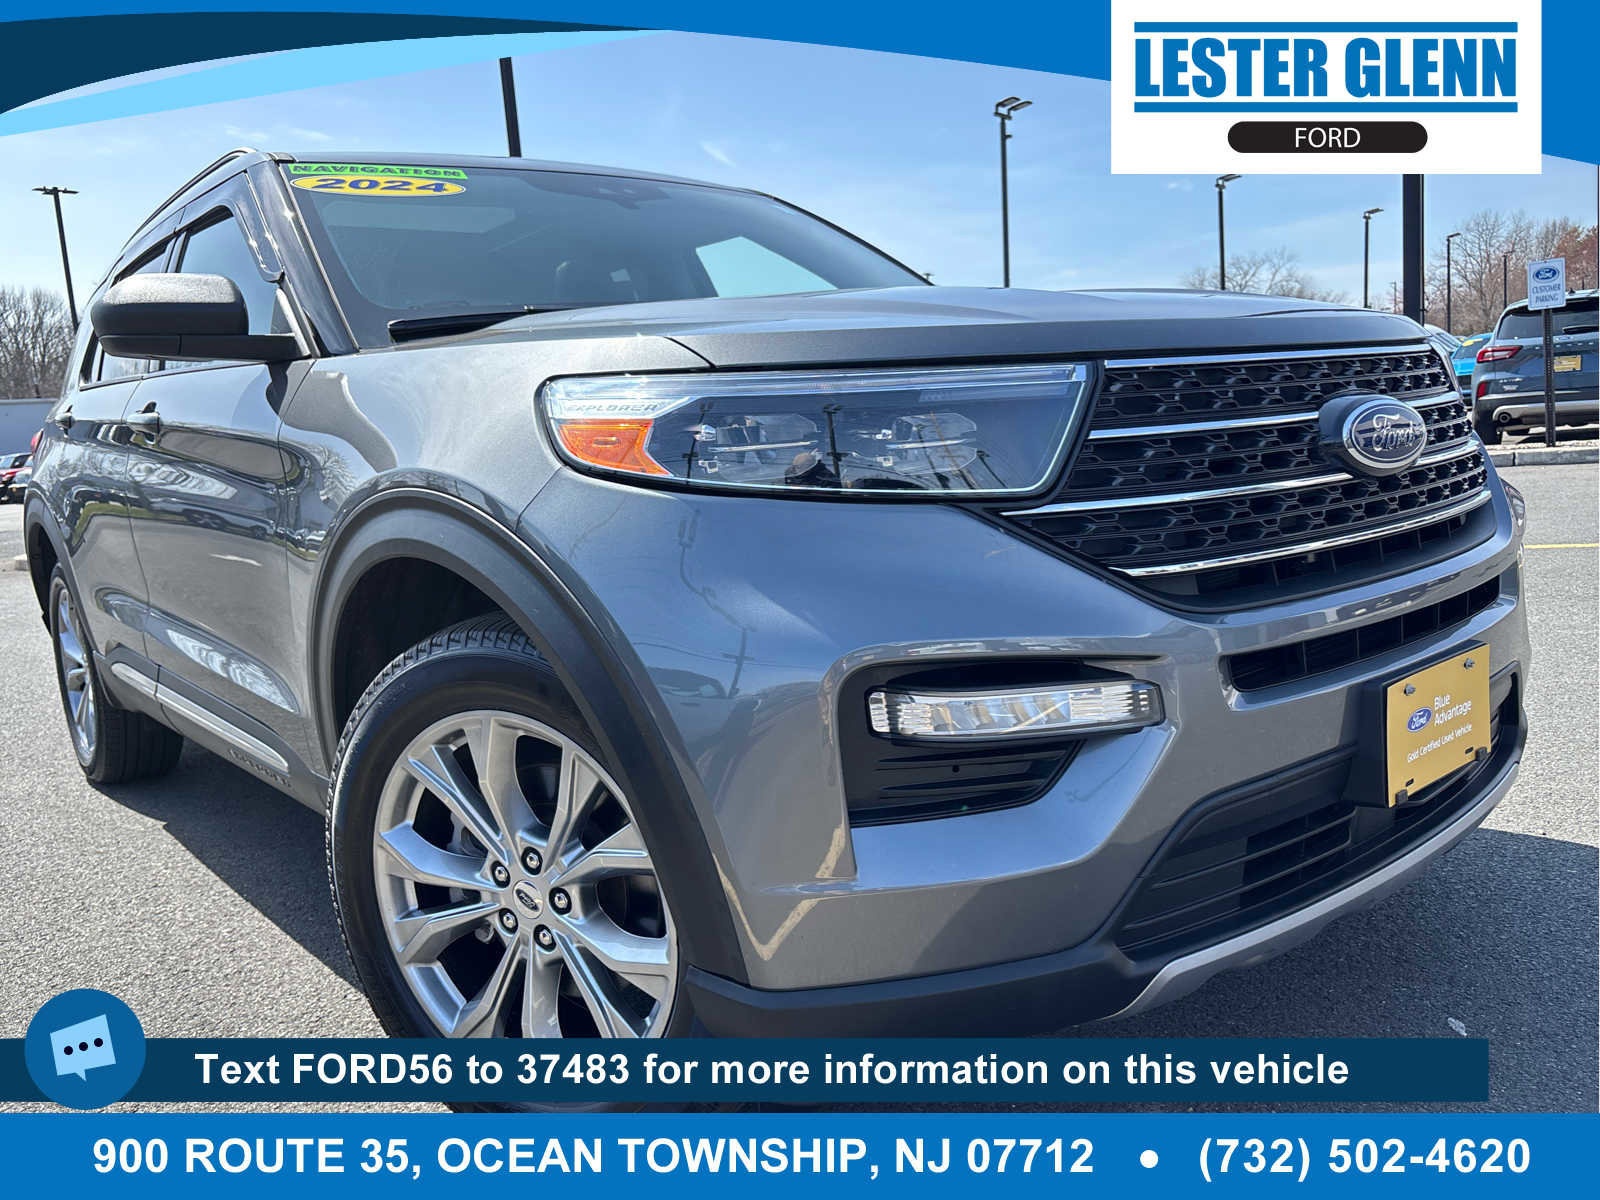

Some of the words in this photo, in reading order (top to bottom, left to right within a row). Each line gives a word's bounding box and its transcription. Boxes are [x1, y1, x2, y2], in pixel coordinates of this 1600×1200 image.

[293, 164, 462, 177] NAVIGATION
[311, 178, 448, 193] 2024
[1532, 284, 1560, 294] CUSTOMER
[1536, 294, 1558, 302] PARKING
[566, 402, 658, 413] EXPLORER
[1372, 414, 1414, 451] Ford
[1434, 693, 1451, 711] Blue
[1434, 700, 1473, 727] Advantage
[1407, 747, 1420, 763] Gold
[1420, 738, 1441, 755] Certified
[1441, 730, 1455, 745] Used
[1455, 722, 1473, 738] Vehicle
